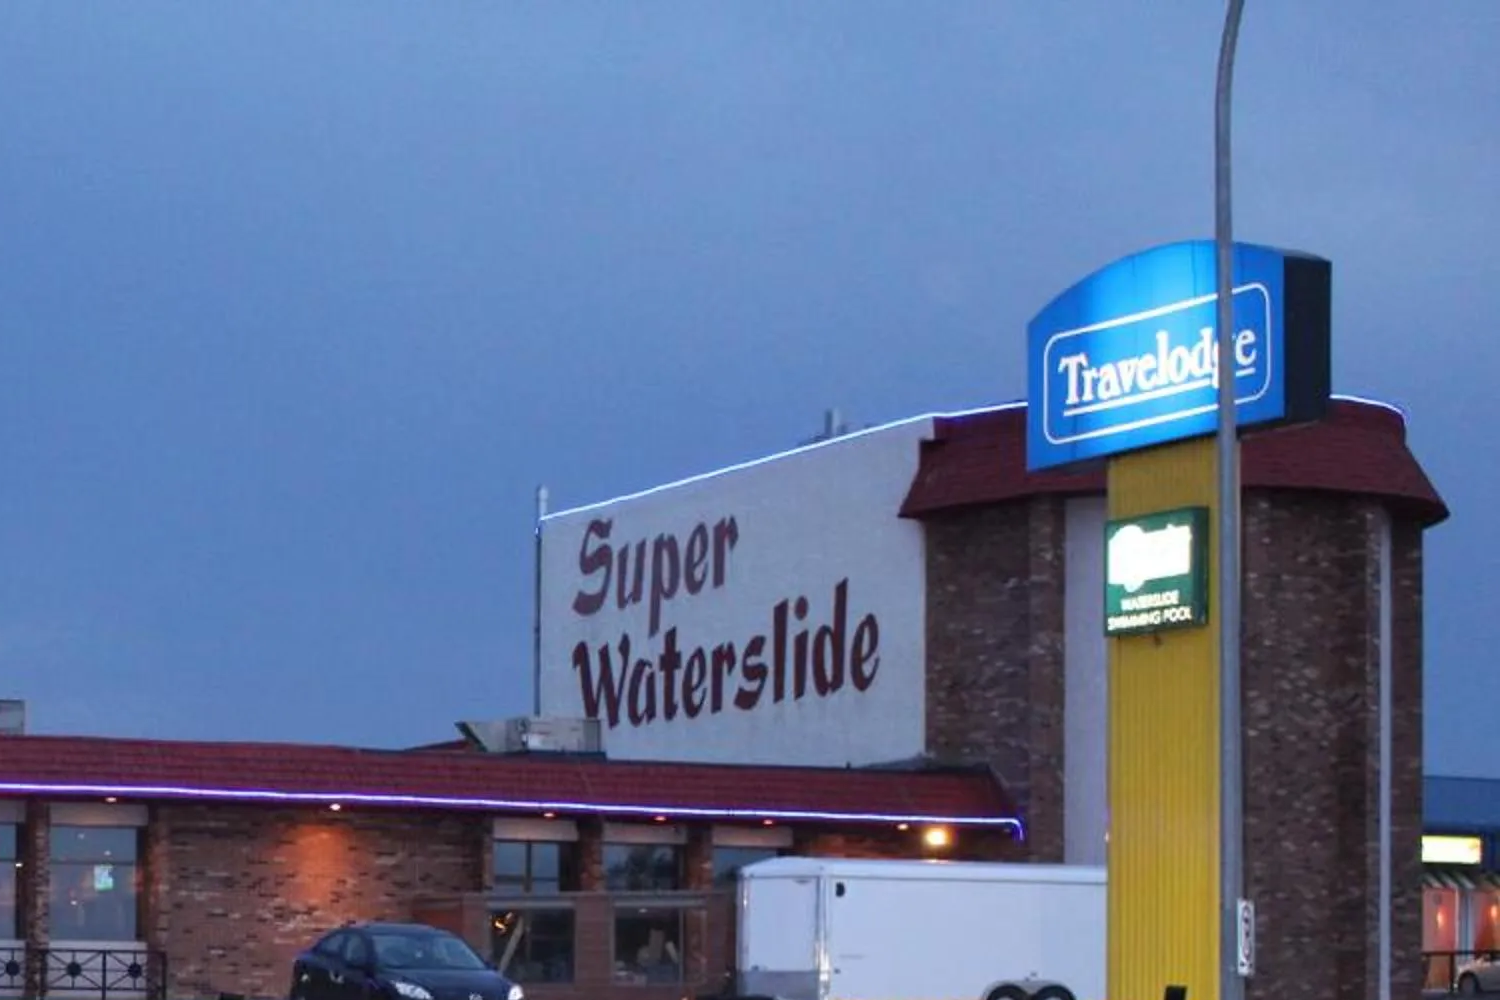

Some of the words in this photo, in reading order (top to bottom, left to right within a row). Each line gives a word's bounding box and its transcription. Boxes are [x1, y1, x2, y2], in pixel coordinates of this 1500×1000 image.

[1058, 327, 1256, 405] Travelode
[573, 515, 739, 638] Super
[572, 577, 880, 729] Waterslide
